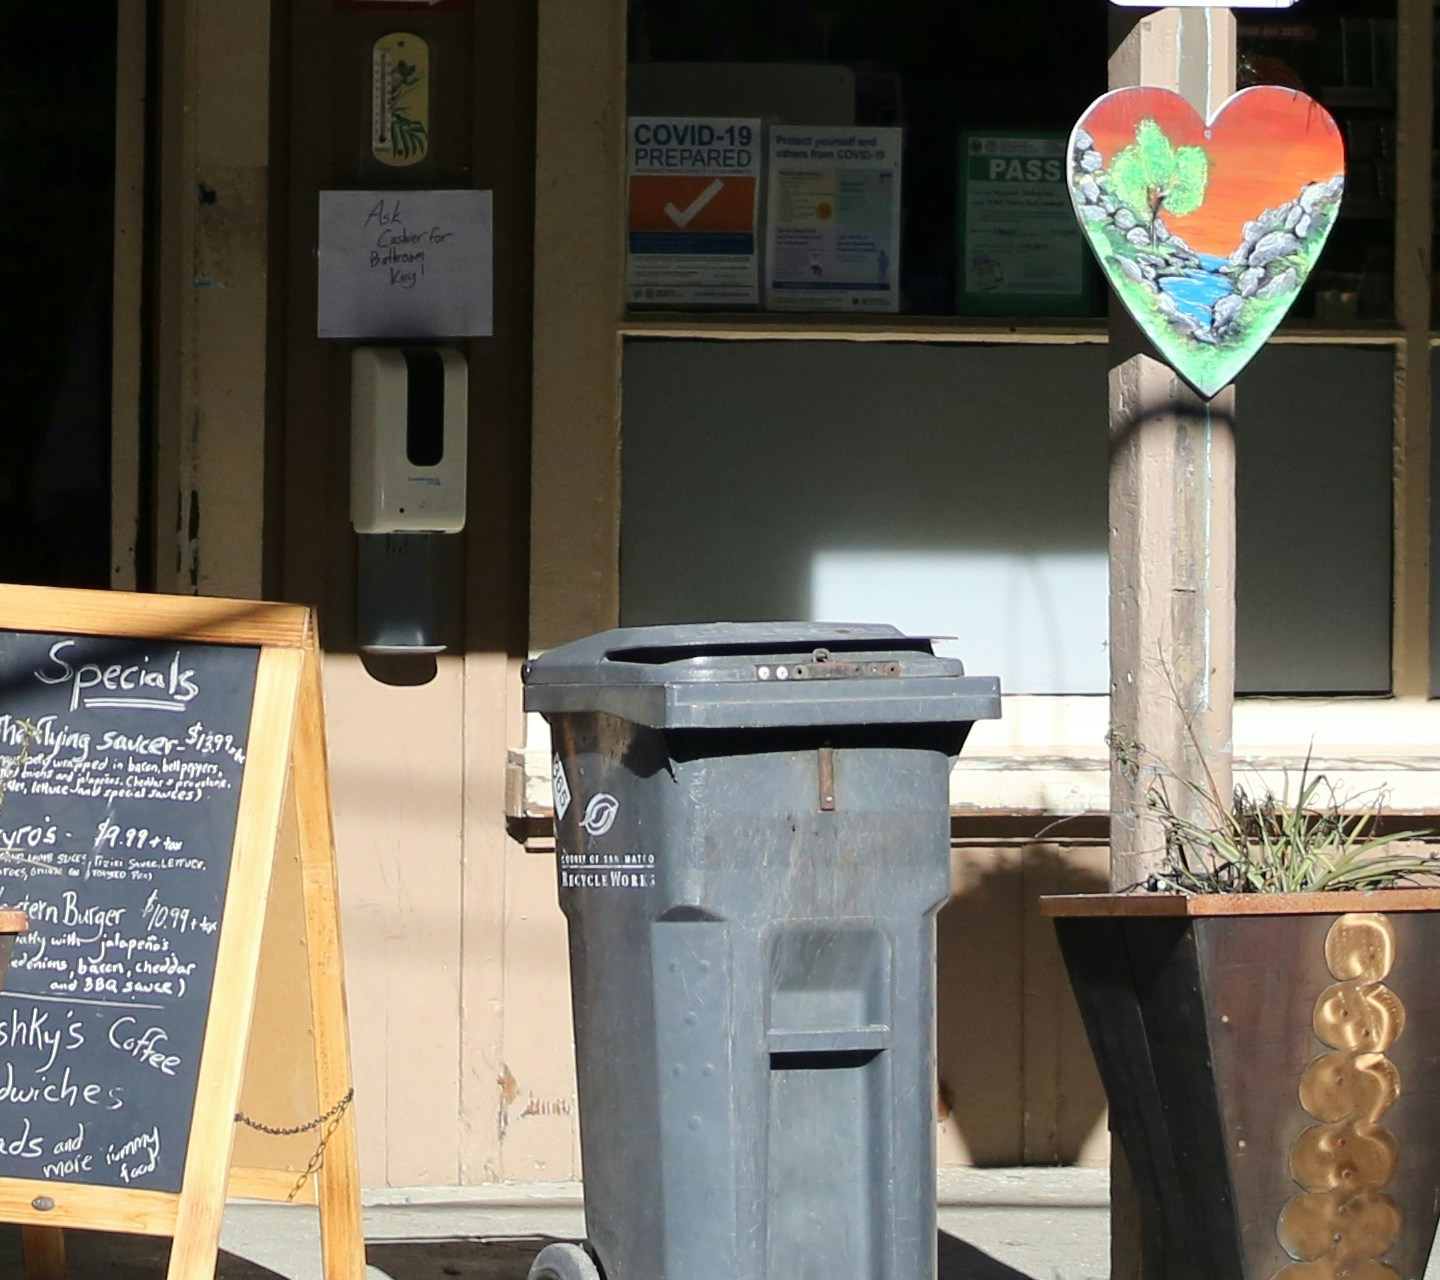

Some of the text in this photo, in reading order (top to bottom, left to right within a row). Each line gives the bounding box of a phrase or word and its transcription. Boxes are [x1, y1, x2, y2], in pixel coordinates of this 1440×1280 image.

[634, 124, 752, 146] COVID-19
[635, 148, 752, 167] PREPARED
[989, 158, 1061, 181] PASS
[363, 200, 402, 228] Ask
[34, 640, 199, 712] Specials
[112, 758, 123, 769] in
[62, 891, 128, 941] Burger
[108, 1016, 182, 1076] Coffee
[53, 1123, 85, 1155] and
